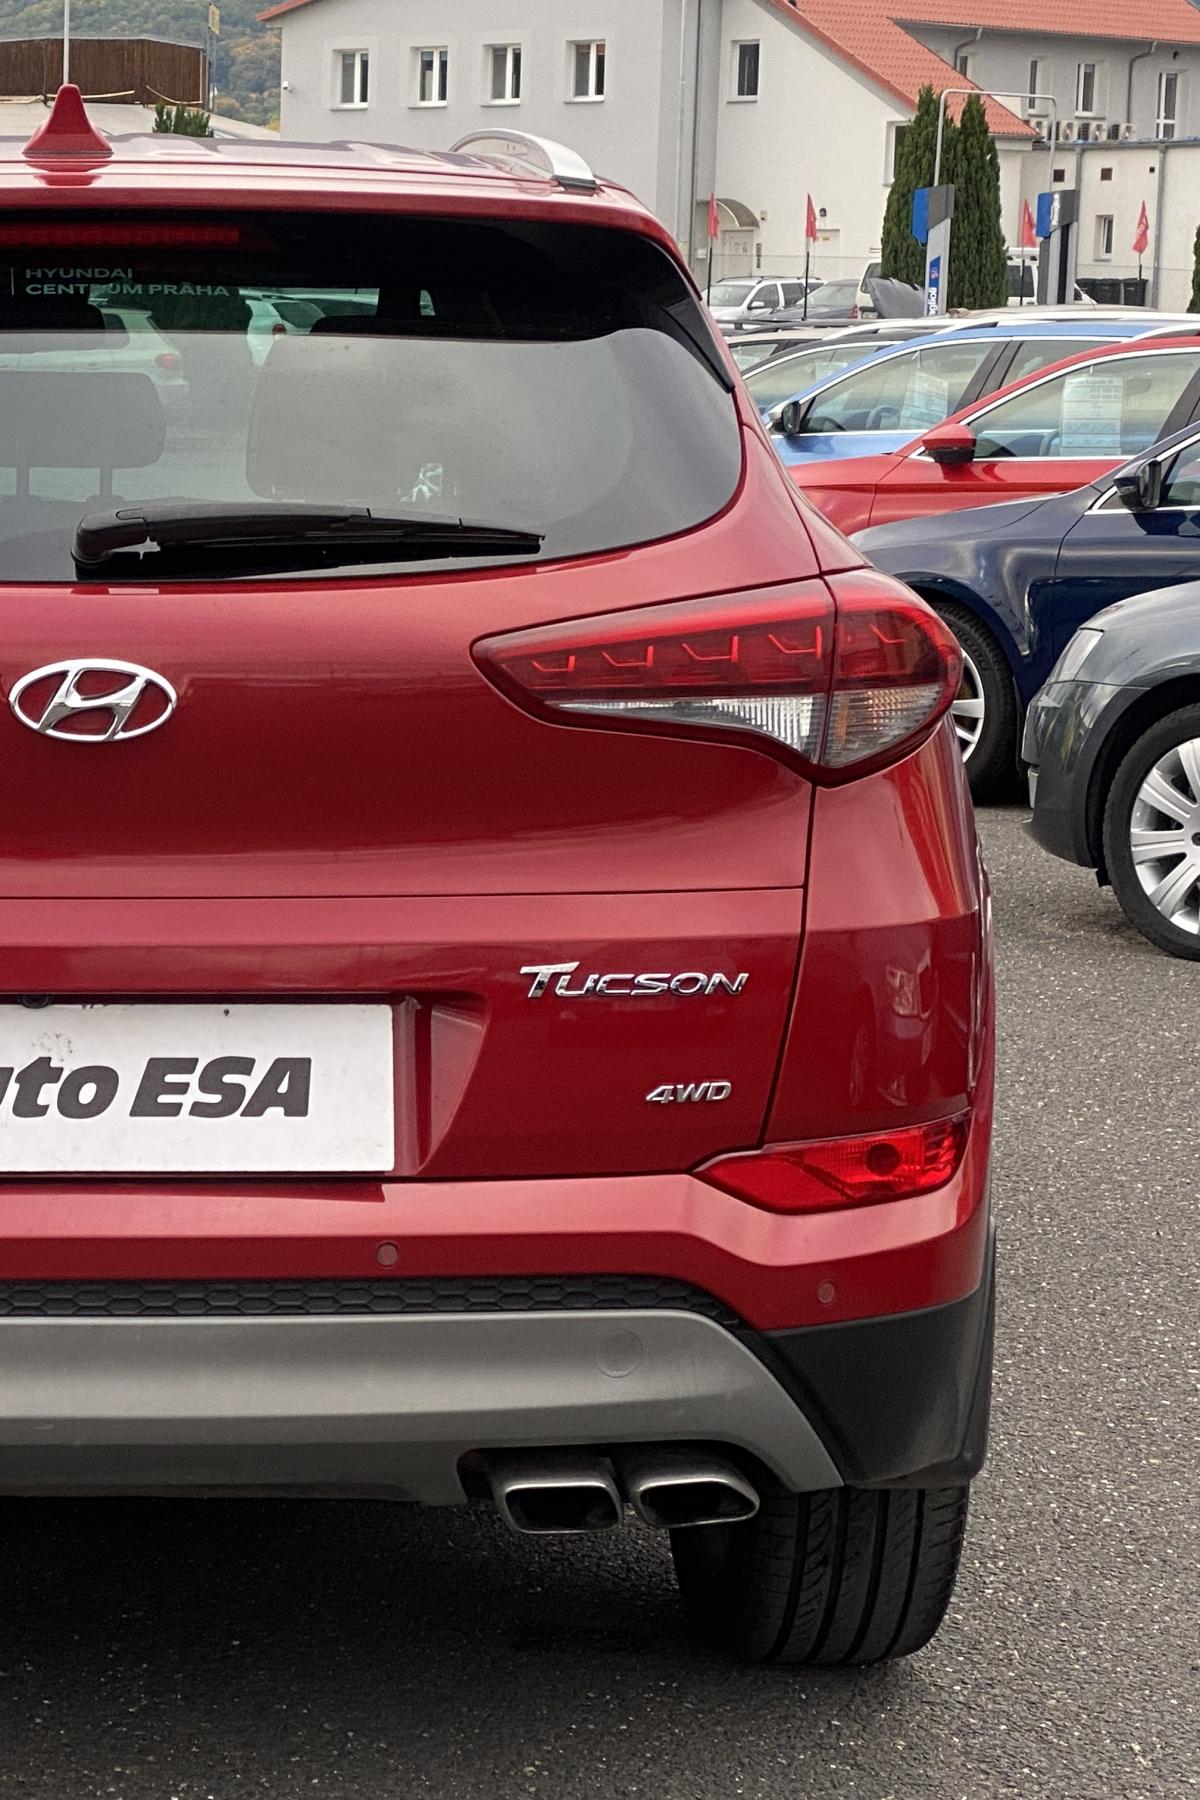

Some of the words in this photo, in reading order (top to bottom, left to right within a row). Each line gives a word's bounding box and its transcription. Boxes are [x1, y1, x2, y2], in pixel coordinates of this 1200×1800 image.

[25, 267, 133, 280] HYUNDAI
[149, 283, 230, 297] PRAHA
[128, 1056, 313, 1118] ESA
[645, 1080, 732, 1104] 4WD
